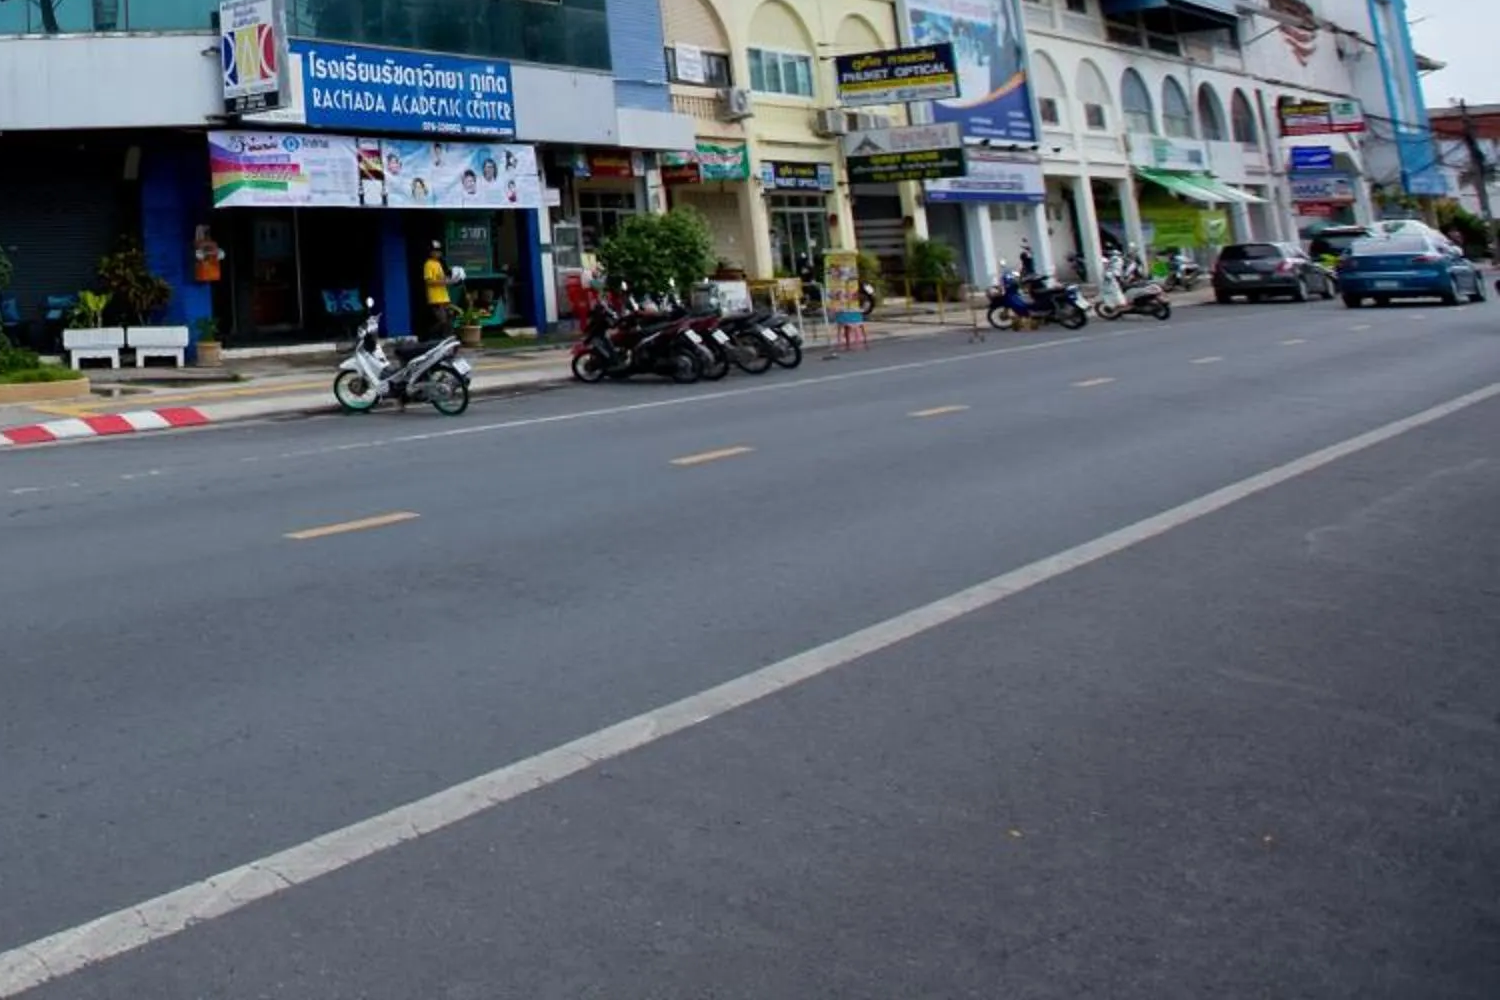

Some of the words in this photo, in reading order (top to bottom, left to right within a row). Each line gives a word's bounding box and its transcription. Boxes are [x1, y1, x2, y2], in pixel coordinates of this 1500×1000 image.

[308, 51, 464, 91] โรงเรียนรัชดาวิทยา
[469, 66, 507, 98] ภูเก็ต
[843, 68, 889, 83] PHUKET
[894, 62, 949, 78] OPTICAL
[312, 87, 387, 113] RACHADA
[391, 93, 462, 119] ACADEMIC
[466, 99, 511, 122] CENTER
